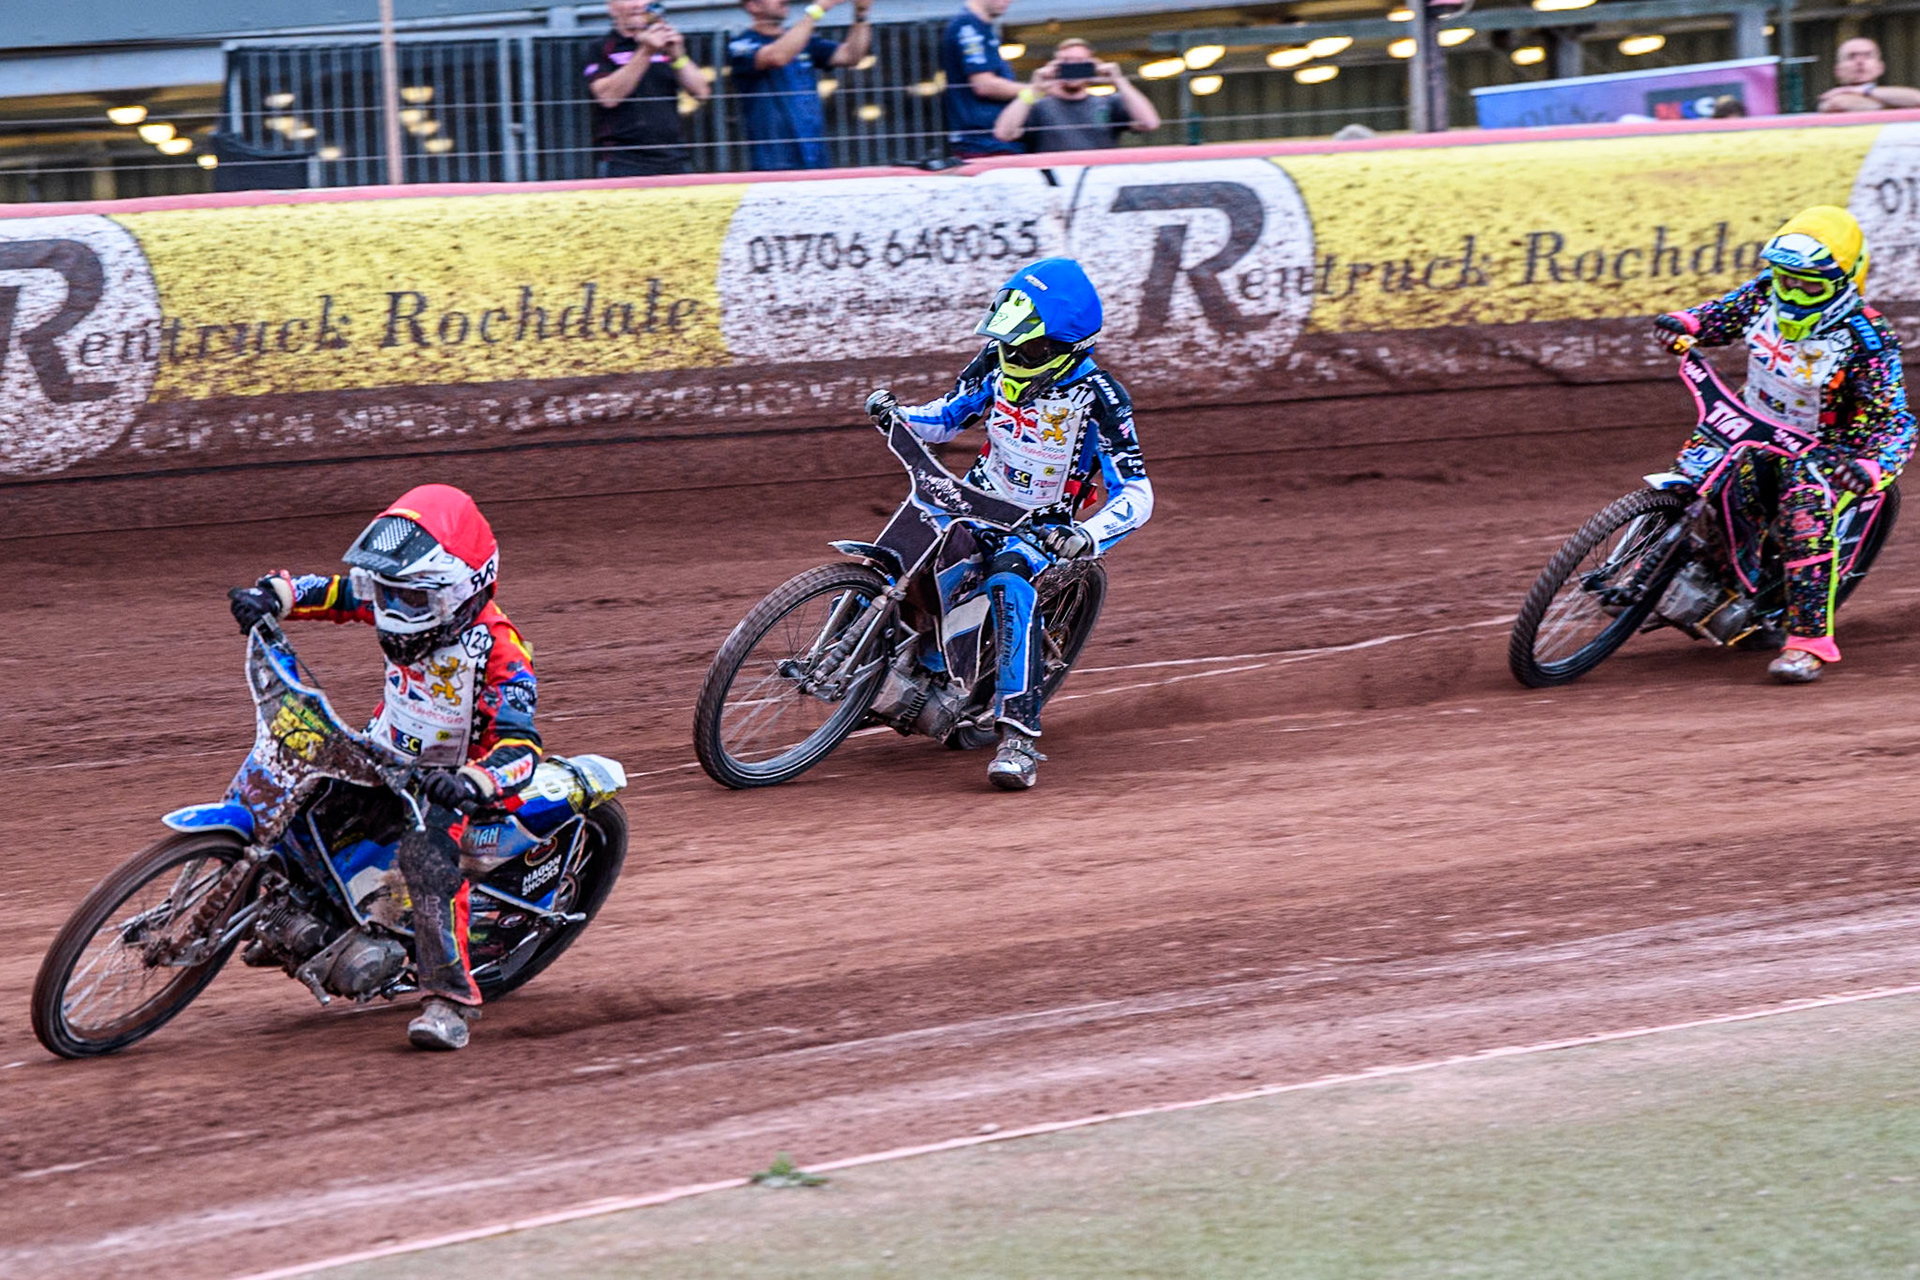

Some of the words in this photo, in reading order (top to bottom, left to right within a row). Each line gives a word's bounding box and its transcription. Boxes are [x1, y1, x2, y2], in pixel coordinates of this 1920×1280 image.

[747, 231, 868, 273] 01706
[884, 220, 1039, 268] 640055
[1513, 221, 1768, 286] Rochda
[379, 277, 697, 349] Rochdale
[464, 629, 491, 649] 123
[521, 865, 560, 896] SHOCKS
[522, 854, 562, 886] HAGON
